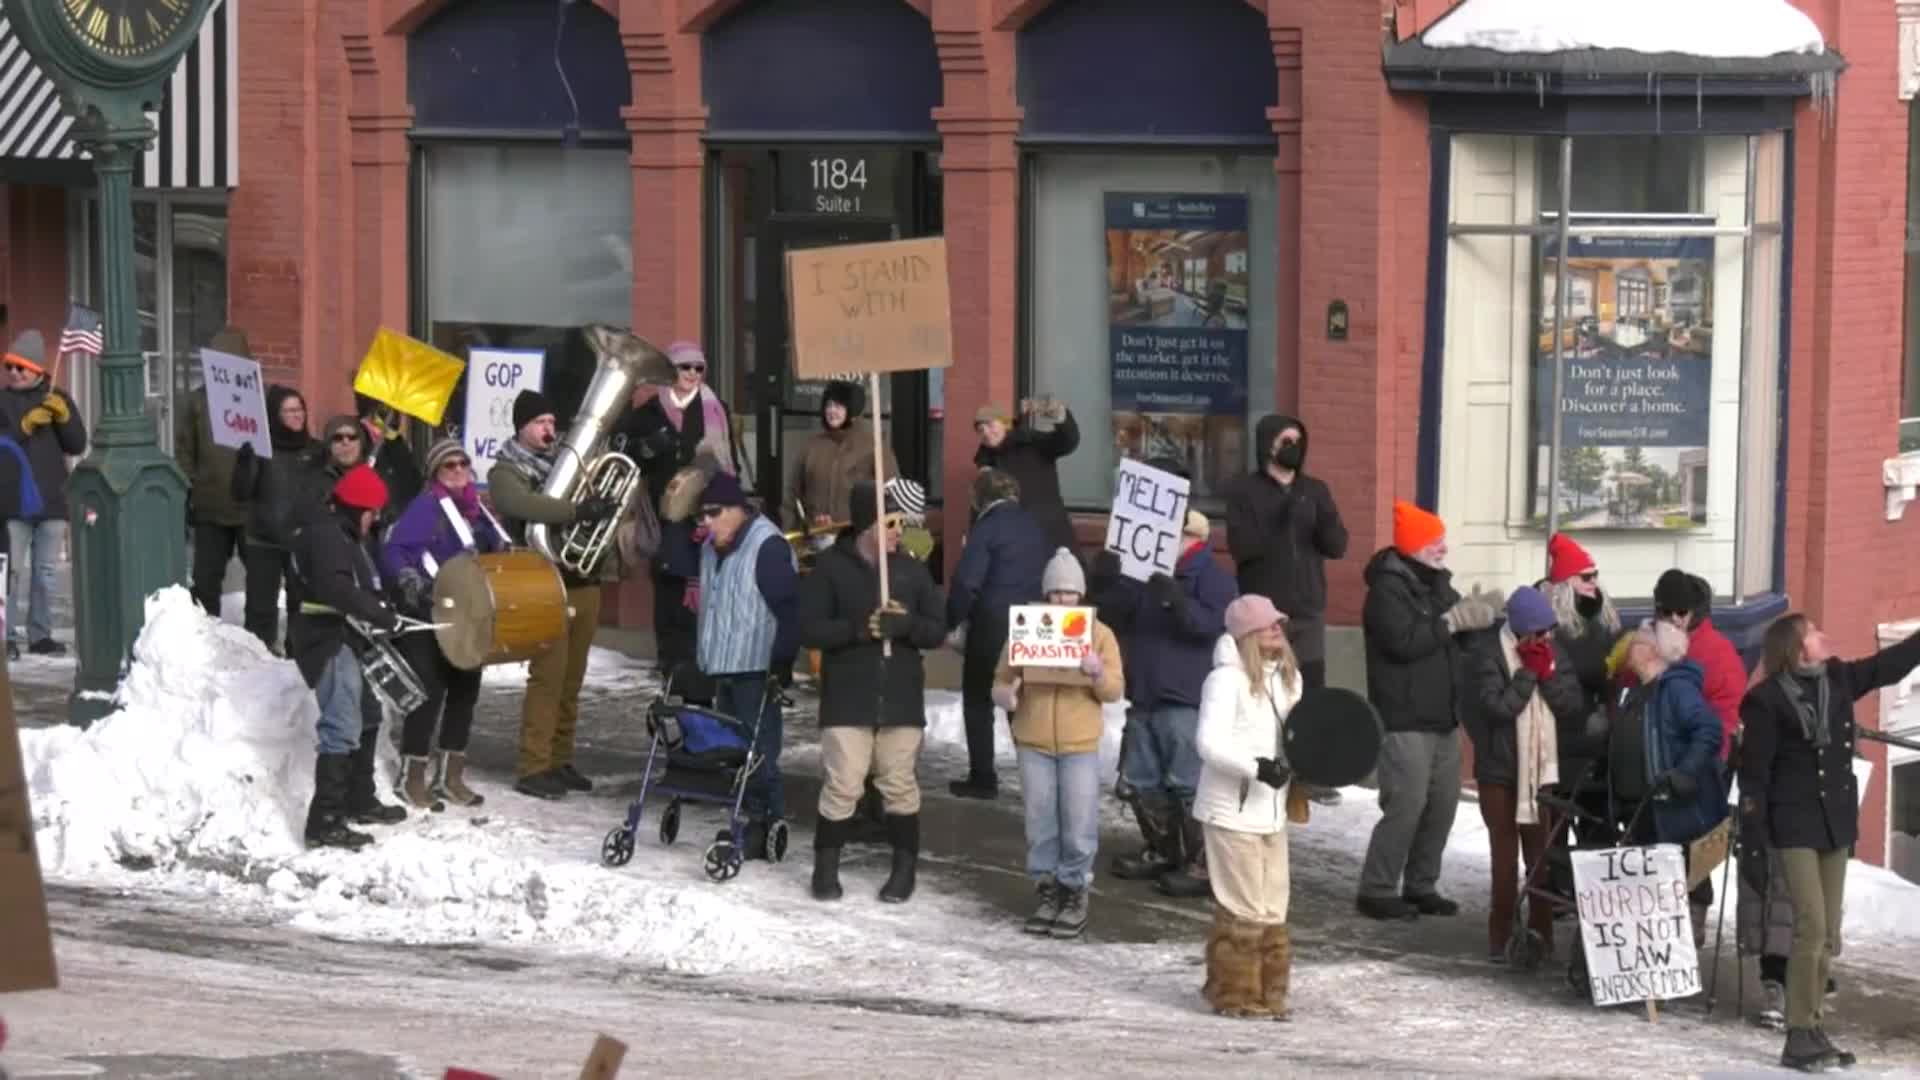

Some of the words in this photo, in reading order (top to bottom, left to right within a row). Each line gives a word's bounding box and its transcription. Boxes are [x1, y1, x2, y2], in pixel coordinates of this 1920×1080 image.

[810, 158, 868, 190] 1184
[816, 195, 851, 212] Suite
[855, 197, 860, 212] 1
[811, 262, 825, 296] I
[840, 255, 931, 290] STAND
[838, 287, 906, 320] WITH
[1115, 350, 1134, 363] the
[1122, 333, 1152, 348] Don't
[1155, 335, 1178, 351] just
[484, 362, 523, 389] GOP
[1114, 367, 1169, 381] attention
[1571, 364, 1611, 379] Don't
[1615, 365, 1645, 381] just
[1647, 365, 1680, 380] look
[1561, 398, 1625, 413] Discover
[1629, 402, 1638, 413] a
[1642, 398, 1686, 413] home.
[1584, 382, 1605, 396] for
[1610, 385, 1618, 396] a
[1622, 382, 1665, 400] place.
[1119, 468, 1190, 522] MELT
[1108, 514, 1176, 571] ICE
[1599, 848, 1658, 882] ICE
[1578, 880, 1688, 920] MURDER
[1593, 922, 1628, 948] IS
[1636, 915, 1686, 943] NOT
[1615, 943, 1673, 972] LAW
